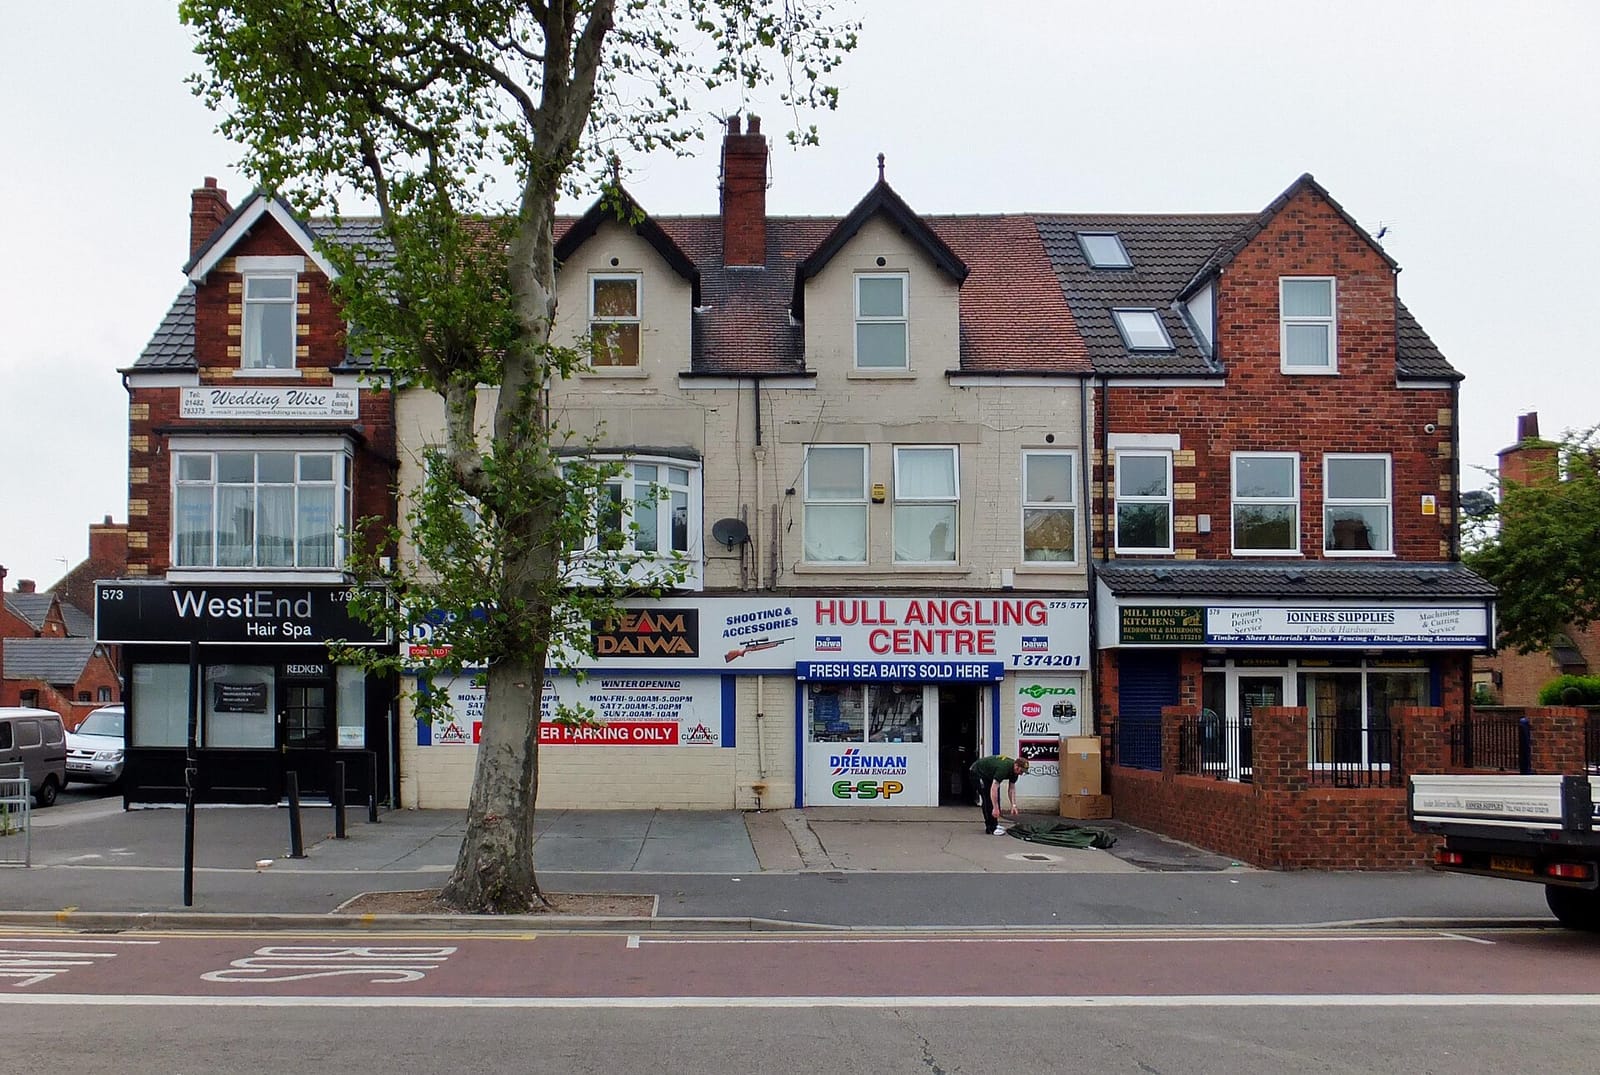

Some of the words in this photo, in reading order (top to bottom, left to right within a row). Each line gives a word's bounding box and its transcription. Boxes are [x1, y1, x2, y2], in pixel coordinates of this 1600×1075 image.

[210, 390, 280, 409] Wedding
[286, 390, 326, 406] Wise
[102, 590, 124, 600] 573
[726, 610, 782, 626] SHOOTING
[784, 607, 792, 616] &
[816, 600, 896, 625] HULL
[904, 600, 1048, 626] ANGLING
[1231, 609, 1260, 620] Prompt
[1287, 612, 1334, 622] JOINERS
[1338, 612, 1395, 622] SUPPLIES
[1419, 610, 1460, 621] Machining
[722, 618, 799, 638] ACCESSORIES
[1231, 617, 1263, 628] Delivery
[1430, 618, 1460, 627] Cutting
[247, 622, 276, 636] Hair
[282, 622, 312, 637] Spa
[1235, 625, 1262, 634] Service
[1305, 625, 1326, 633] Tools
[1329, 625, 1336, 633] &
[1338, 625, 1377, 633] Hardware
[1428, 625, 1456, 634] Service
[597, 636, 694, 654] DAIWA
[816, 640, 841, 648] Daiwa
[869, 629, 997, 655] CENTRE
[1022, 640, 1048, 648] Daiwa
[1012, 655, 1021, 666] T
[1023, 655, 1081, 667] 374201
[287, 665, 323, 674] REDKEN
[809, 664, 850, 678] FRESH
[853, 664, 877, 678] SEA
[881, 664, 916, 678] BAITS
[919, 664, 952, 678] SOLD
[956, 664, 989, 678] HERE
[1023, 706, 1041, 714] PENN
[1017, 719, 1050, 734] Sensas
[564, 727, 629, 739] PARKING
[633, 728, 672, 739] ONLY
[830, 756, 907, 768] DRENNAN
[199, 946, 458, 984] BUS
